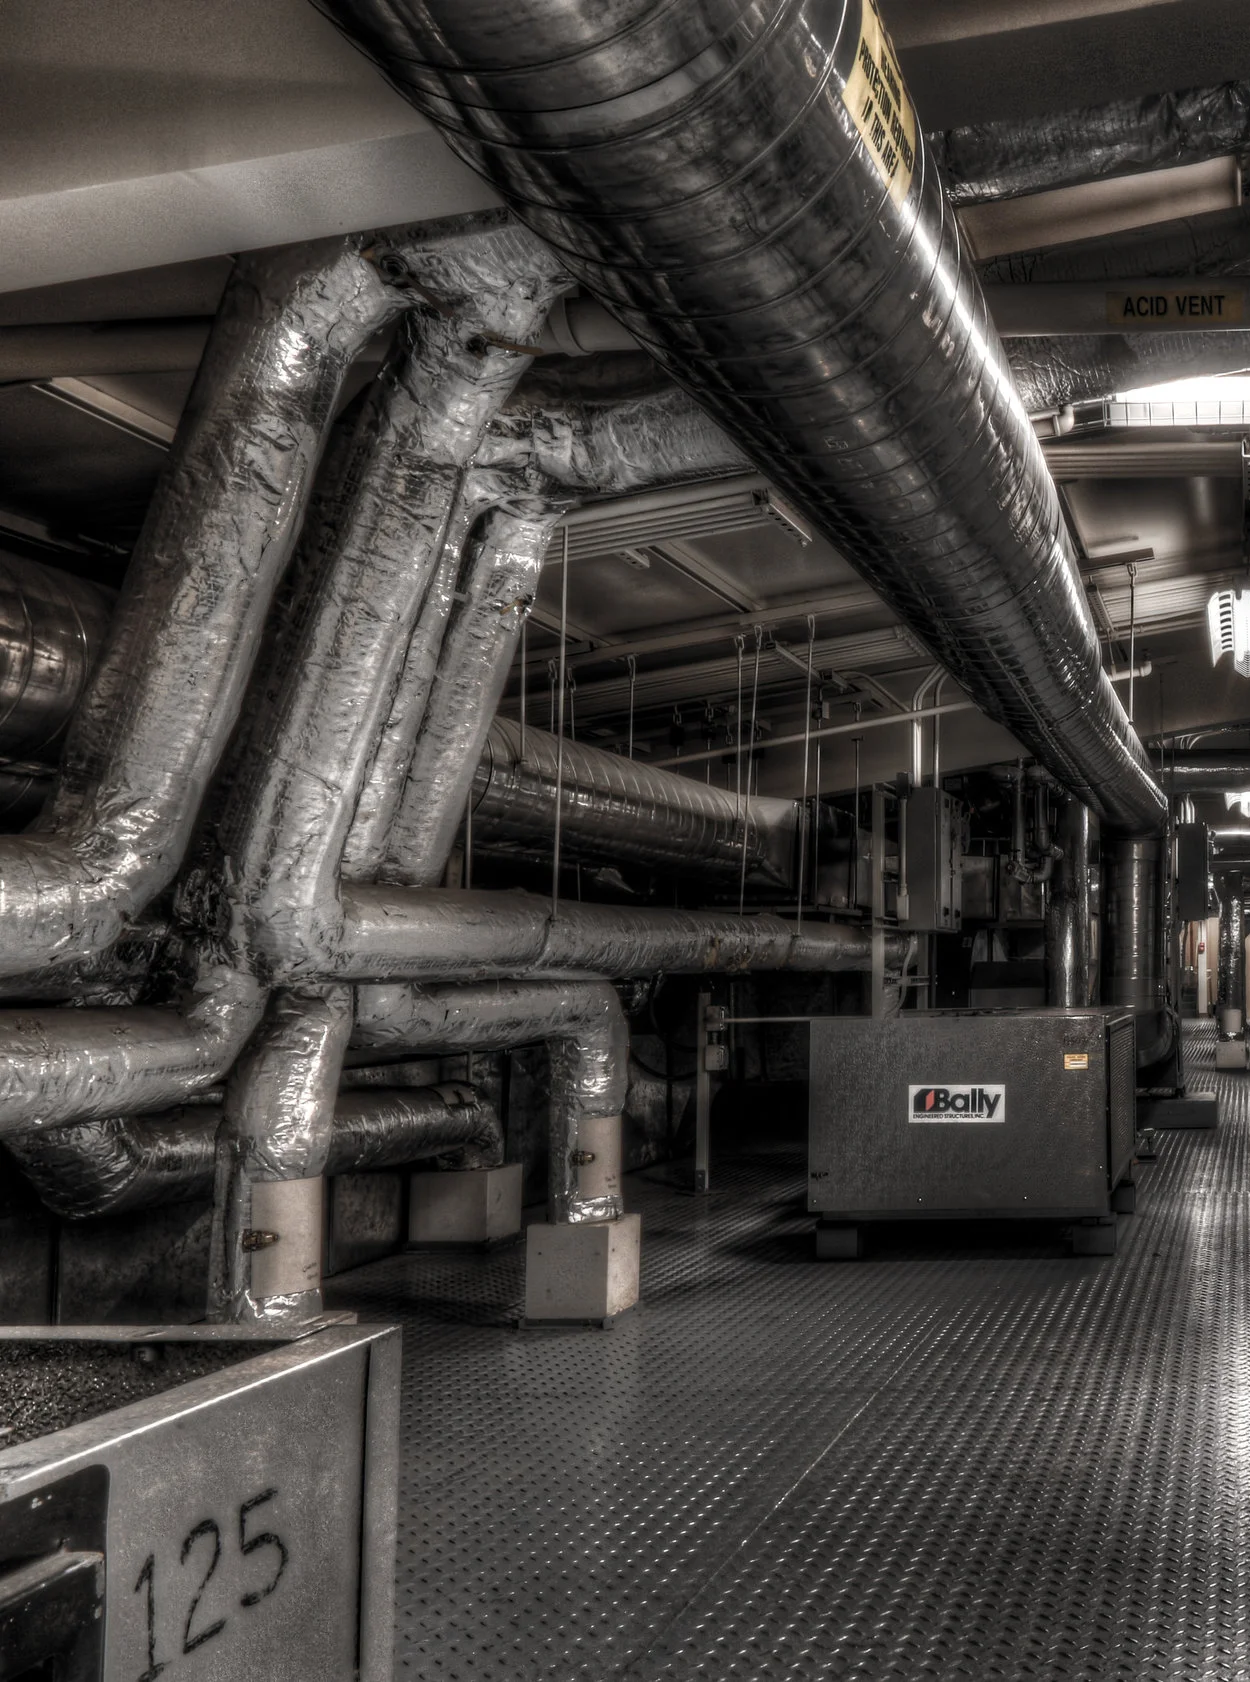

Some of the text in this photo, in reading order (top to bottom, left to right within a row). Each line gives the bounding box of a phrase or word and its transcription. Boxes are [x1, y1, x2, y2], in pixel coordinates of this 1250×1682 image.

[858, 37, 914, 174] PROTECTION REQUIRED
[869, 112, 886, 153] THIS
[1123, 295, 1225, 317] ACID VENT
[934, 1088, 1001, 1118] Bally
[134, 1488, 289, 1682] 125
